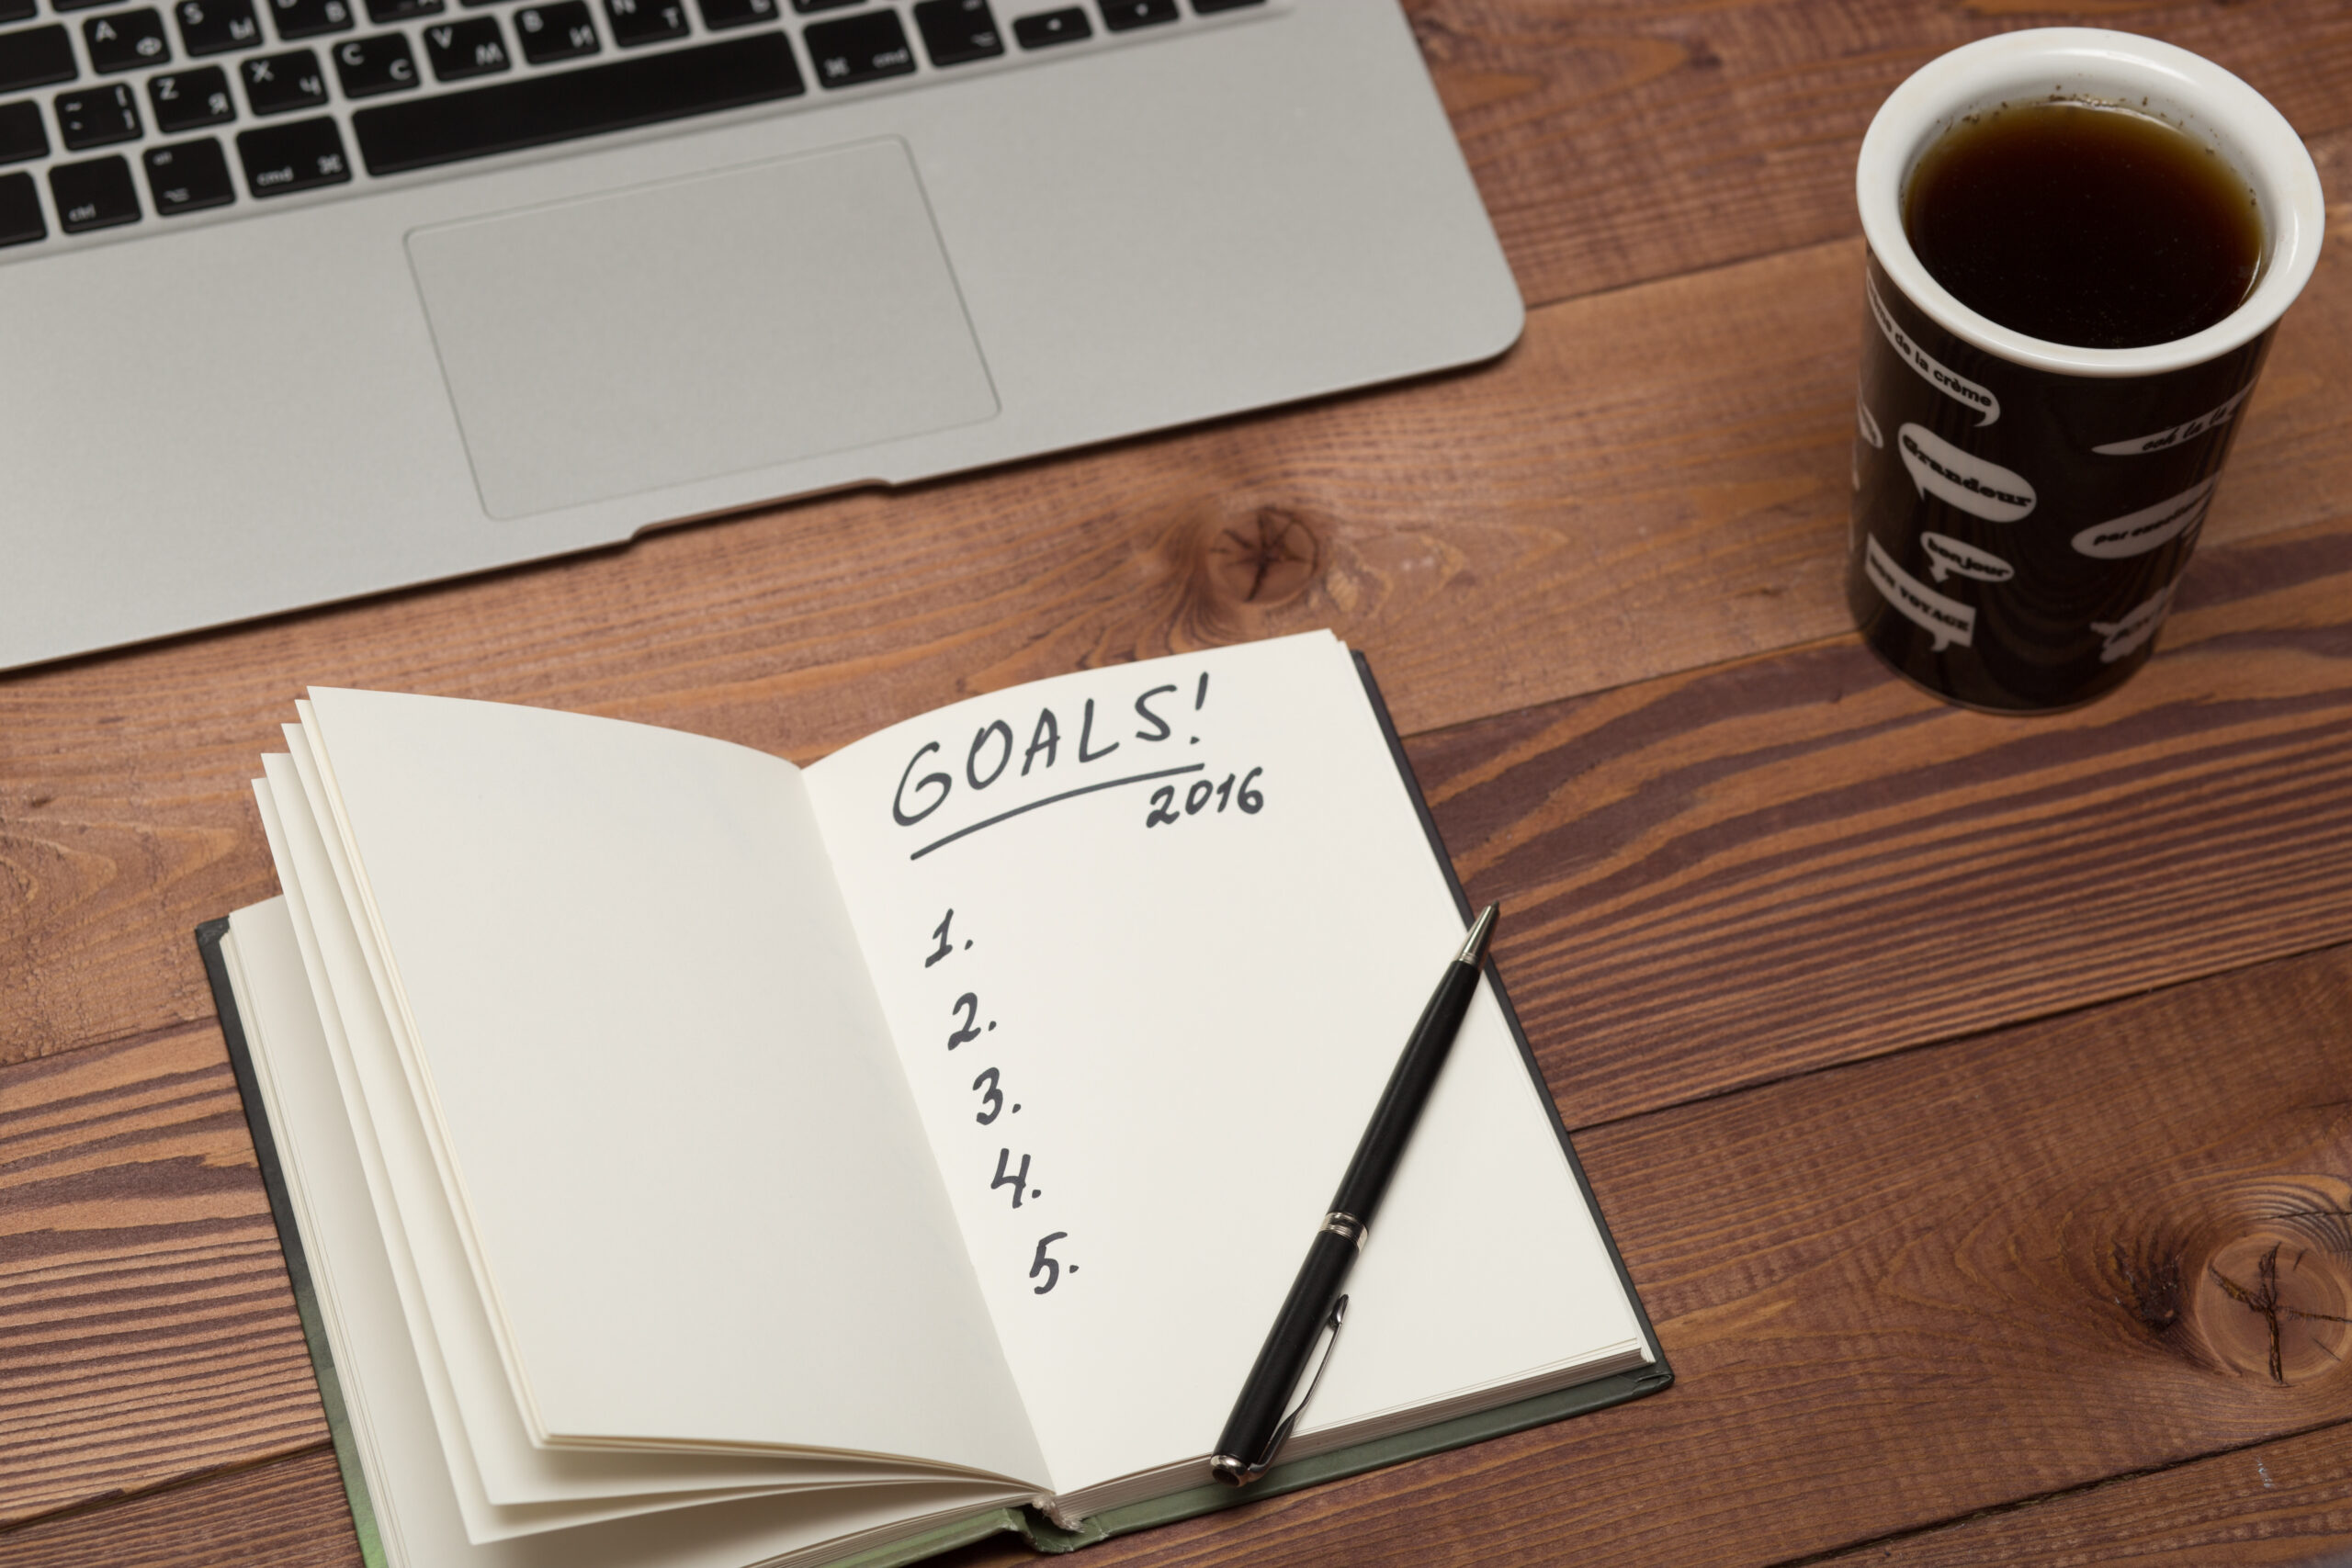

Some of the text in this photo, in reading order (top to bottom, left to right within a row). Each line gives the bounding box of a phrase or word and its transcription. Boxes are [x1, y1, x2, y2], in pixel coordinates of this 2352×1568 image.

[184, 2, 204, 25] S
[522, 10, 543, 33] B
[95, 19, 117, 42] A
[432, 27, 453, 49] V
[342, 43, 365, 66] C
[872, 47, 910, 69] cmd
[251, 60, 275, 84] X
[157, 76, 179, 101] Z
[208, 93, 230, 115] Я
[256, 166, 294, 186] cmd
[68, 203, 96, 222] ctrl
[1894, 333, 1992, 407] de la crème
[892, 671, 1209, 827] GOALS!
[1146, 766, 1265, 829] 2016
[924, 908, 974, 969] 1.
[947, 991, 997, 1051] 2.
[972, 1066, 1022, 1126] 3.
[989, 1147, 1042, 1210] 4.
[1028, 1231, 1080, 1295] 5.
